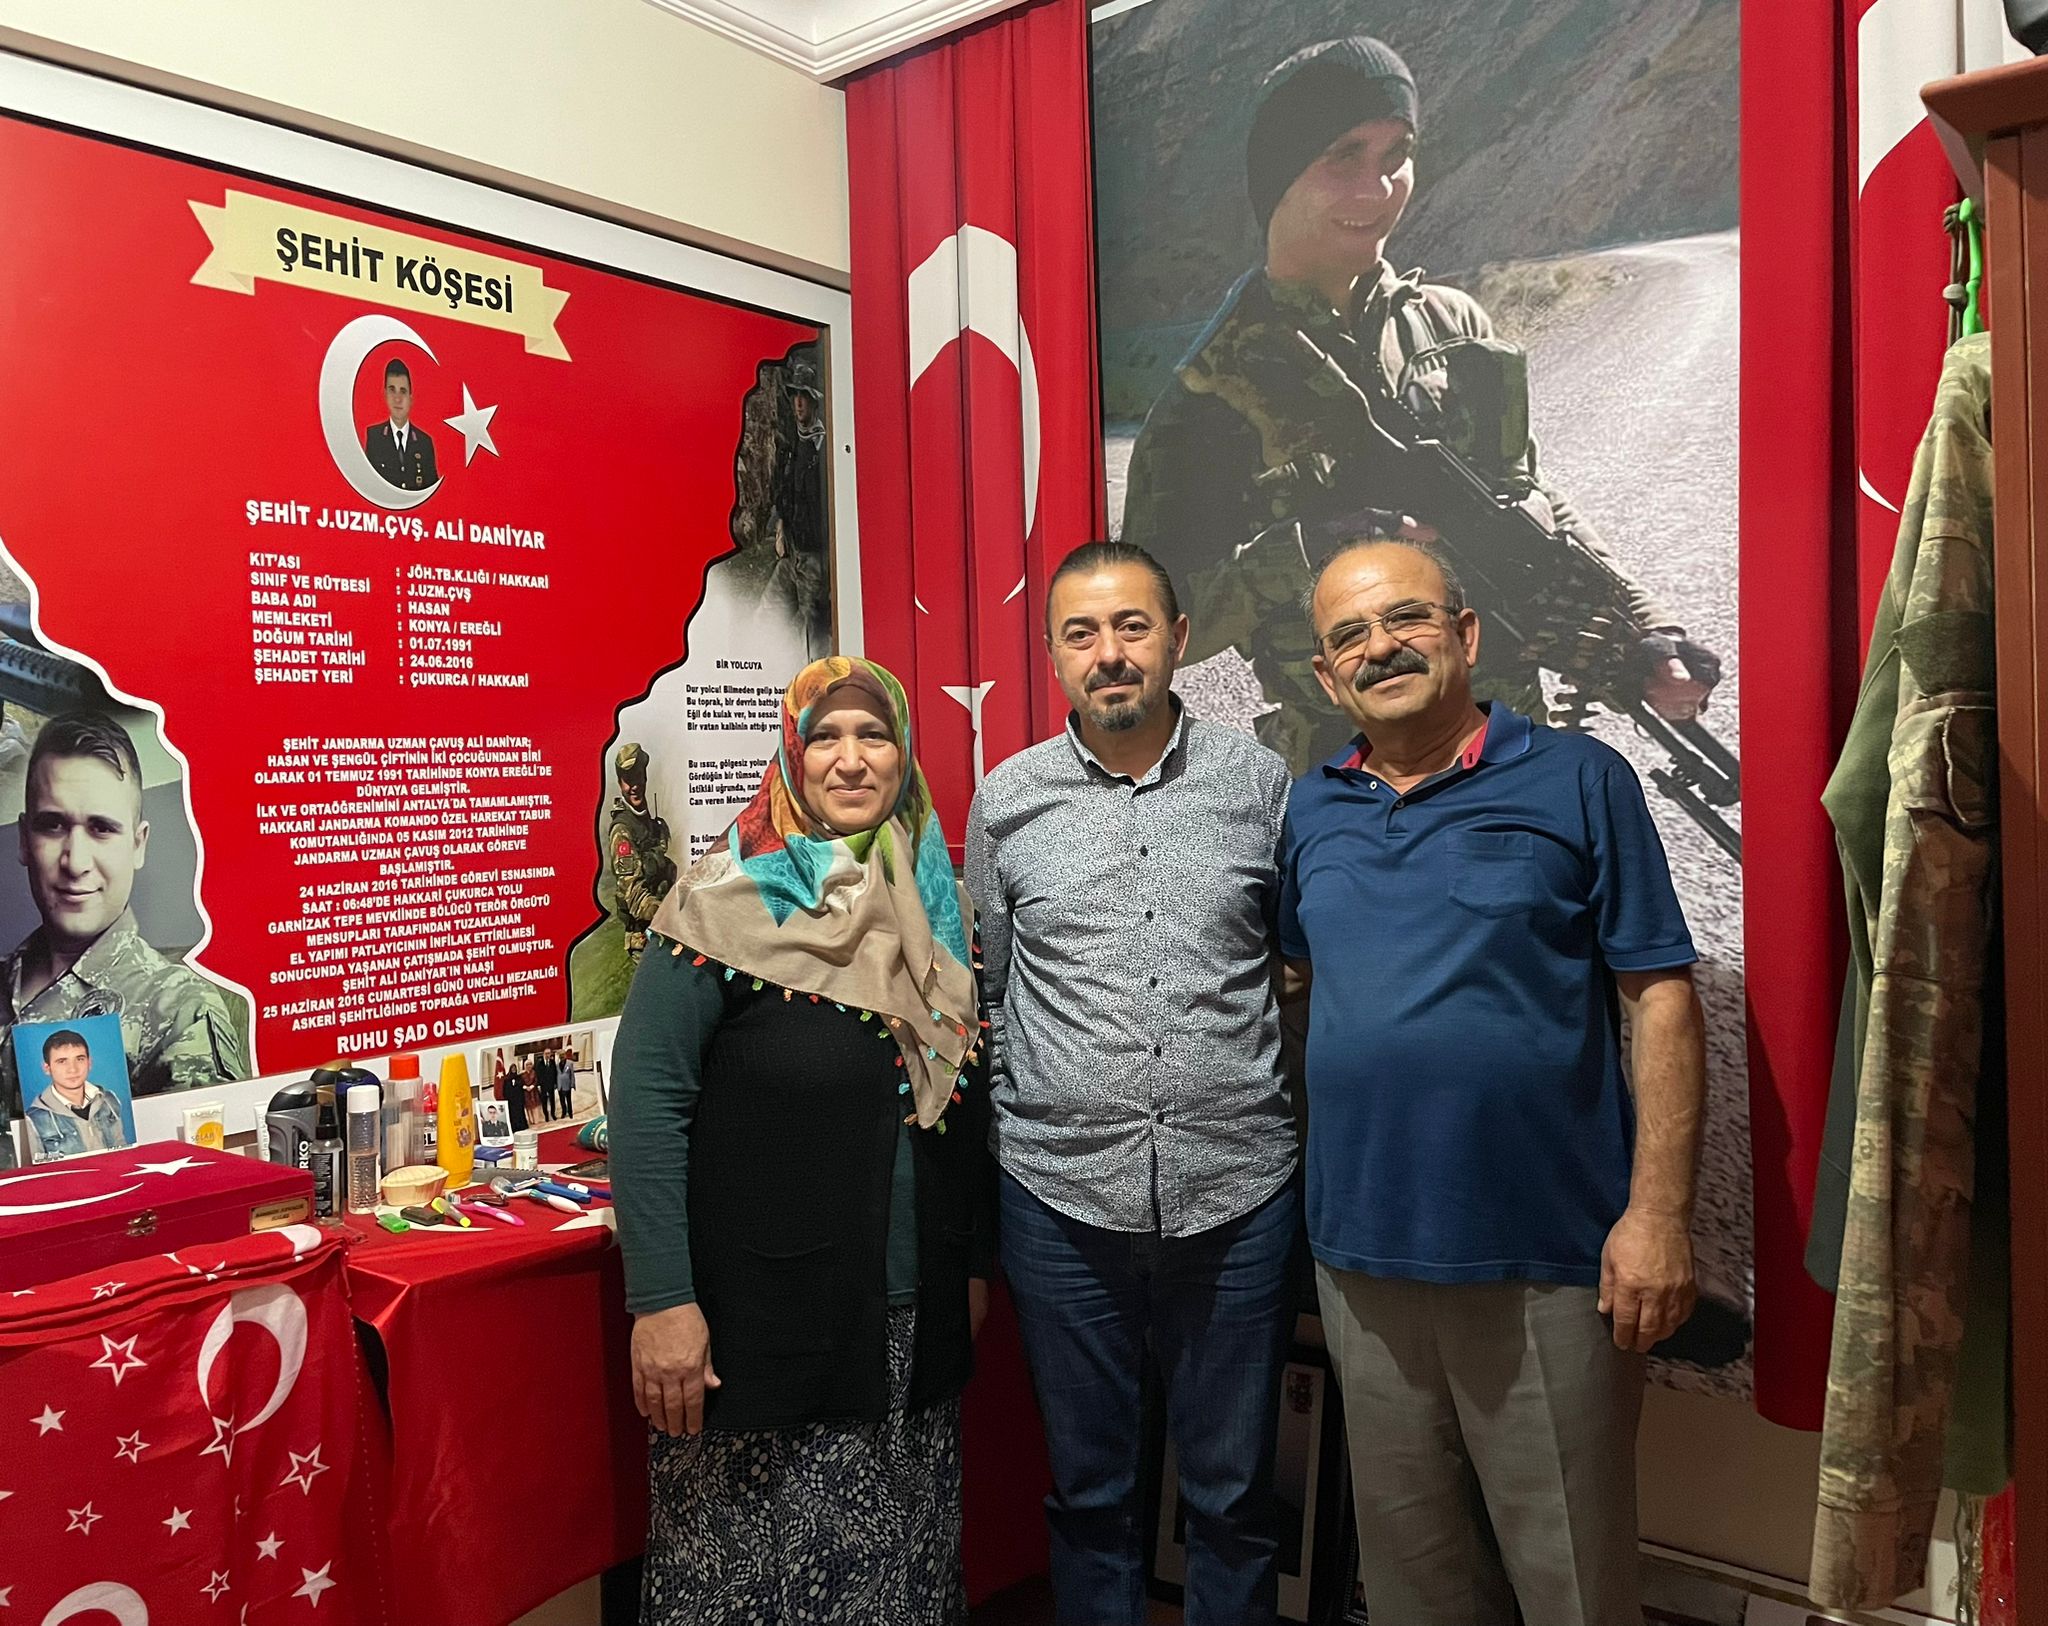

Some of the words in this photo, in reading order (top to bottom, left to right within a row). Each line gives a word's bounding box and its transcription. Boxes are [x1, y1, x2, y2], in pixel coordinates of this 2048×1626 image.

[276, 228, 384, 282] ŞEHİT
[396, 256, 514, 314] KÖŞESİ
[246, 500, 310, 525] ŞEHİT
[317, 508, 429, 542] J.UZM.ÇVŞ.
[434, 519, 464, 541] ALİ
[470, 524, 545, 549] DANİYAR
[251, 572, 287, 587] SINIF
[291, 574, 310, 589] VE
[314, 575, 370, 593] RÜTBESİ
[407, 584, 471, 603] J.UZM.ÇVŞ
[499, 573, 548, 589] HAKKARİ
[251, 591, 289, 606] BABA
[293, 594, 316, 608] ADI
[408, 601, 450, 616] HASAN
[252, 610, 332, 627] MEMLEKETİ
[409, 619, 451, 633] KONYA
[460, 621, 501, 636] EREĞLİ
[253, 628, 304, 645] DOĞUM
[308, 630, 352, 647] TARİHİ
[410, 637, 471, 651] 01.07.1991
[254, 648, 317, 665] ŞEHADET
[321, 650, 365, 665] TARİHİ
[410, 654, 473, 669] 24.06.2016
[730, 661, 763, 670] YOLCUYA
[255, 668, 318, 684] ŞEHADET
[322, 668, 353, 683] YERİ
[410, 672, 469, 688] ÇUKURCA
[478, 673, 528, 687] HAKKARİ
[686, 697, 696, 705] Bu
[283, 736, 319, 753] ŞEHİT
[322, 738, 385, 749] JANDARMA
[388, 738, 426, 749] UZMAN
[429, 737, 464, 750] ÇAVUŞ
[467, 735, 483, 748] ALİ
[268, 755, 309, 767] HASAN
[312, 754, 328, 766] VE
[332, 752, 378, 768] ŞENGÜL
[381, 751, 428, 767] ÇİFTİNİN
[431, 751, 446, 763] İKİ
[449, 750, 520, 765] ÇOCUĞUNDAN
[521, 750, 541, 762] BİRİ
[688, 760, 698, 768] Bu
[255, 771, 305, 784] OLARAK
[308, 771, 321, 782] 01
[325, 770, 374, 782] TEMMUZ
[377, 769, 402, 780] 1991
[406, 766, 463, 780] TARİHİNDE
[465, 767, 500, 778] KONYA
[357, 784, 408, 797] DÜNYAYA
[411, 781, 470, 796] GELMİŞTİR.
[689, 797, 703, 805] Can
[705, 797, 724, 805] veren
[257, 803, 277, 817] İLK
[280, 805, 297, 816] VE
[469, 795, 552, 808] TAMAMLAMIŞTIR.
[260, 818, 315, 834] HAKKARİ
[318, 817, 381, 831] JANDARMA
[384, 814, 438, 828] KOMANDO
[441, 812, 468, 824] ÖZEL
[471, 811, 517, 823] HAREKAT
[519, 809, 551, 820] TABUR
[290, 832, 394, 849] KOMUTANLIĞINDA
[397, 831, 409, 843] 05
[413, 829, 446, 842] KASIM
[449, 828, 473, 839] 2012
[475, 824, 529, 837] TARİHİNDE
[294, 850, 358, 865] JANDARMA
[361, 848, 401, 861] UZMAN
[404, 845, 440, 860] ÇAVUŞ
[442, 842, 484, 855] OLARAK
[487, 839, 526, 852] GÖREVE
[380, 860, 455, 877] BAŞLAMIŞTIR.
[300, 886, 314, 898] 24
[317, 881, 368, 896] HAZİRAN
[372, 879, 398, 892] 2016
[400, 874, 458, 889] TARİHİNDE
[461, 869, 498, 884] GÖREVİ
[501, 867, 555, 880] ESNASINDA
[302, 900, 333, 914] SAAT
[393, 889, 442, 906] HAKKARİ
[445, 887, 494, 903] ÇUKURCA
[497, 884, 522, 896] YOLU
[268, 917, 330, 934] GARNİZAK
[333, 914, 363, 927] TEPE
[430, 902, 472, 917] BÖLÜCÜ
[474, 899, 508, 913] TERÖR
[510, 894, 550, 909] ÖRGÜTÜ
[307, 928, 380, 946] MENSUPLARI
[384, 921, 451, 938] TARAFINDAN
[454, 913, 521, 930] TUZAKLANAN
[290, 953, 305, 965] EL
[308, 947, 348, 962] YAPIMI
[352, 938, 427, 957] PATLAYICININ
[430, 933, 471, 948] İNFİLAK
[474, 924, 535, 943] ETTİRİLMESİ
[270, 964, 345, 984] SONUCUNDA
[348, 957, 401, 975] YAŞANAN
[403, 950, 464, 970] ÇATIŞMADA
[466, 944, 496, 962] ŞEHİT
[499, 939, 554, 955] OLMUŞTUR.
[343, 975, 376, 993] ŞEHİT
[379, 970, 398, 986] ALİ
[464, 961, 494, 977] NAAŞI
[263, 1005, 278, 1018] 25
[281, 998, 334, 1016] HAZİRAN
[338, 993, 364, 1008] 2016
[368, 982, 431, 1003] CUMARTESİ
[434, 978, 464, 994] GÜNÜ
[467, 974, 504, 989] UNCALI
[507, 965, 558, 983] MEZARLIĞI
[292, 1011, 336, 1031] ASKERİ
[339, 1002, 417, 1026] ŞEHİTLİĞİNDE
[420, 993, 469, 1011] TOPRAĞA
[472, 984, 536, 1003] VERİLMİŞTİR.
[337, 1030, 387, 1054] RUHU
[394, 1024, 428, 1048] ŞAD
[433, 1013, 488, 1037] OLSUN
[299, 1140, 309, 1169] RKO
